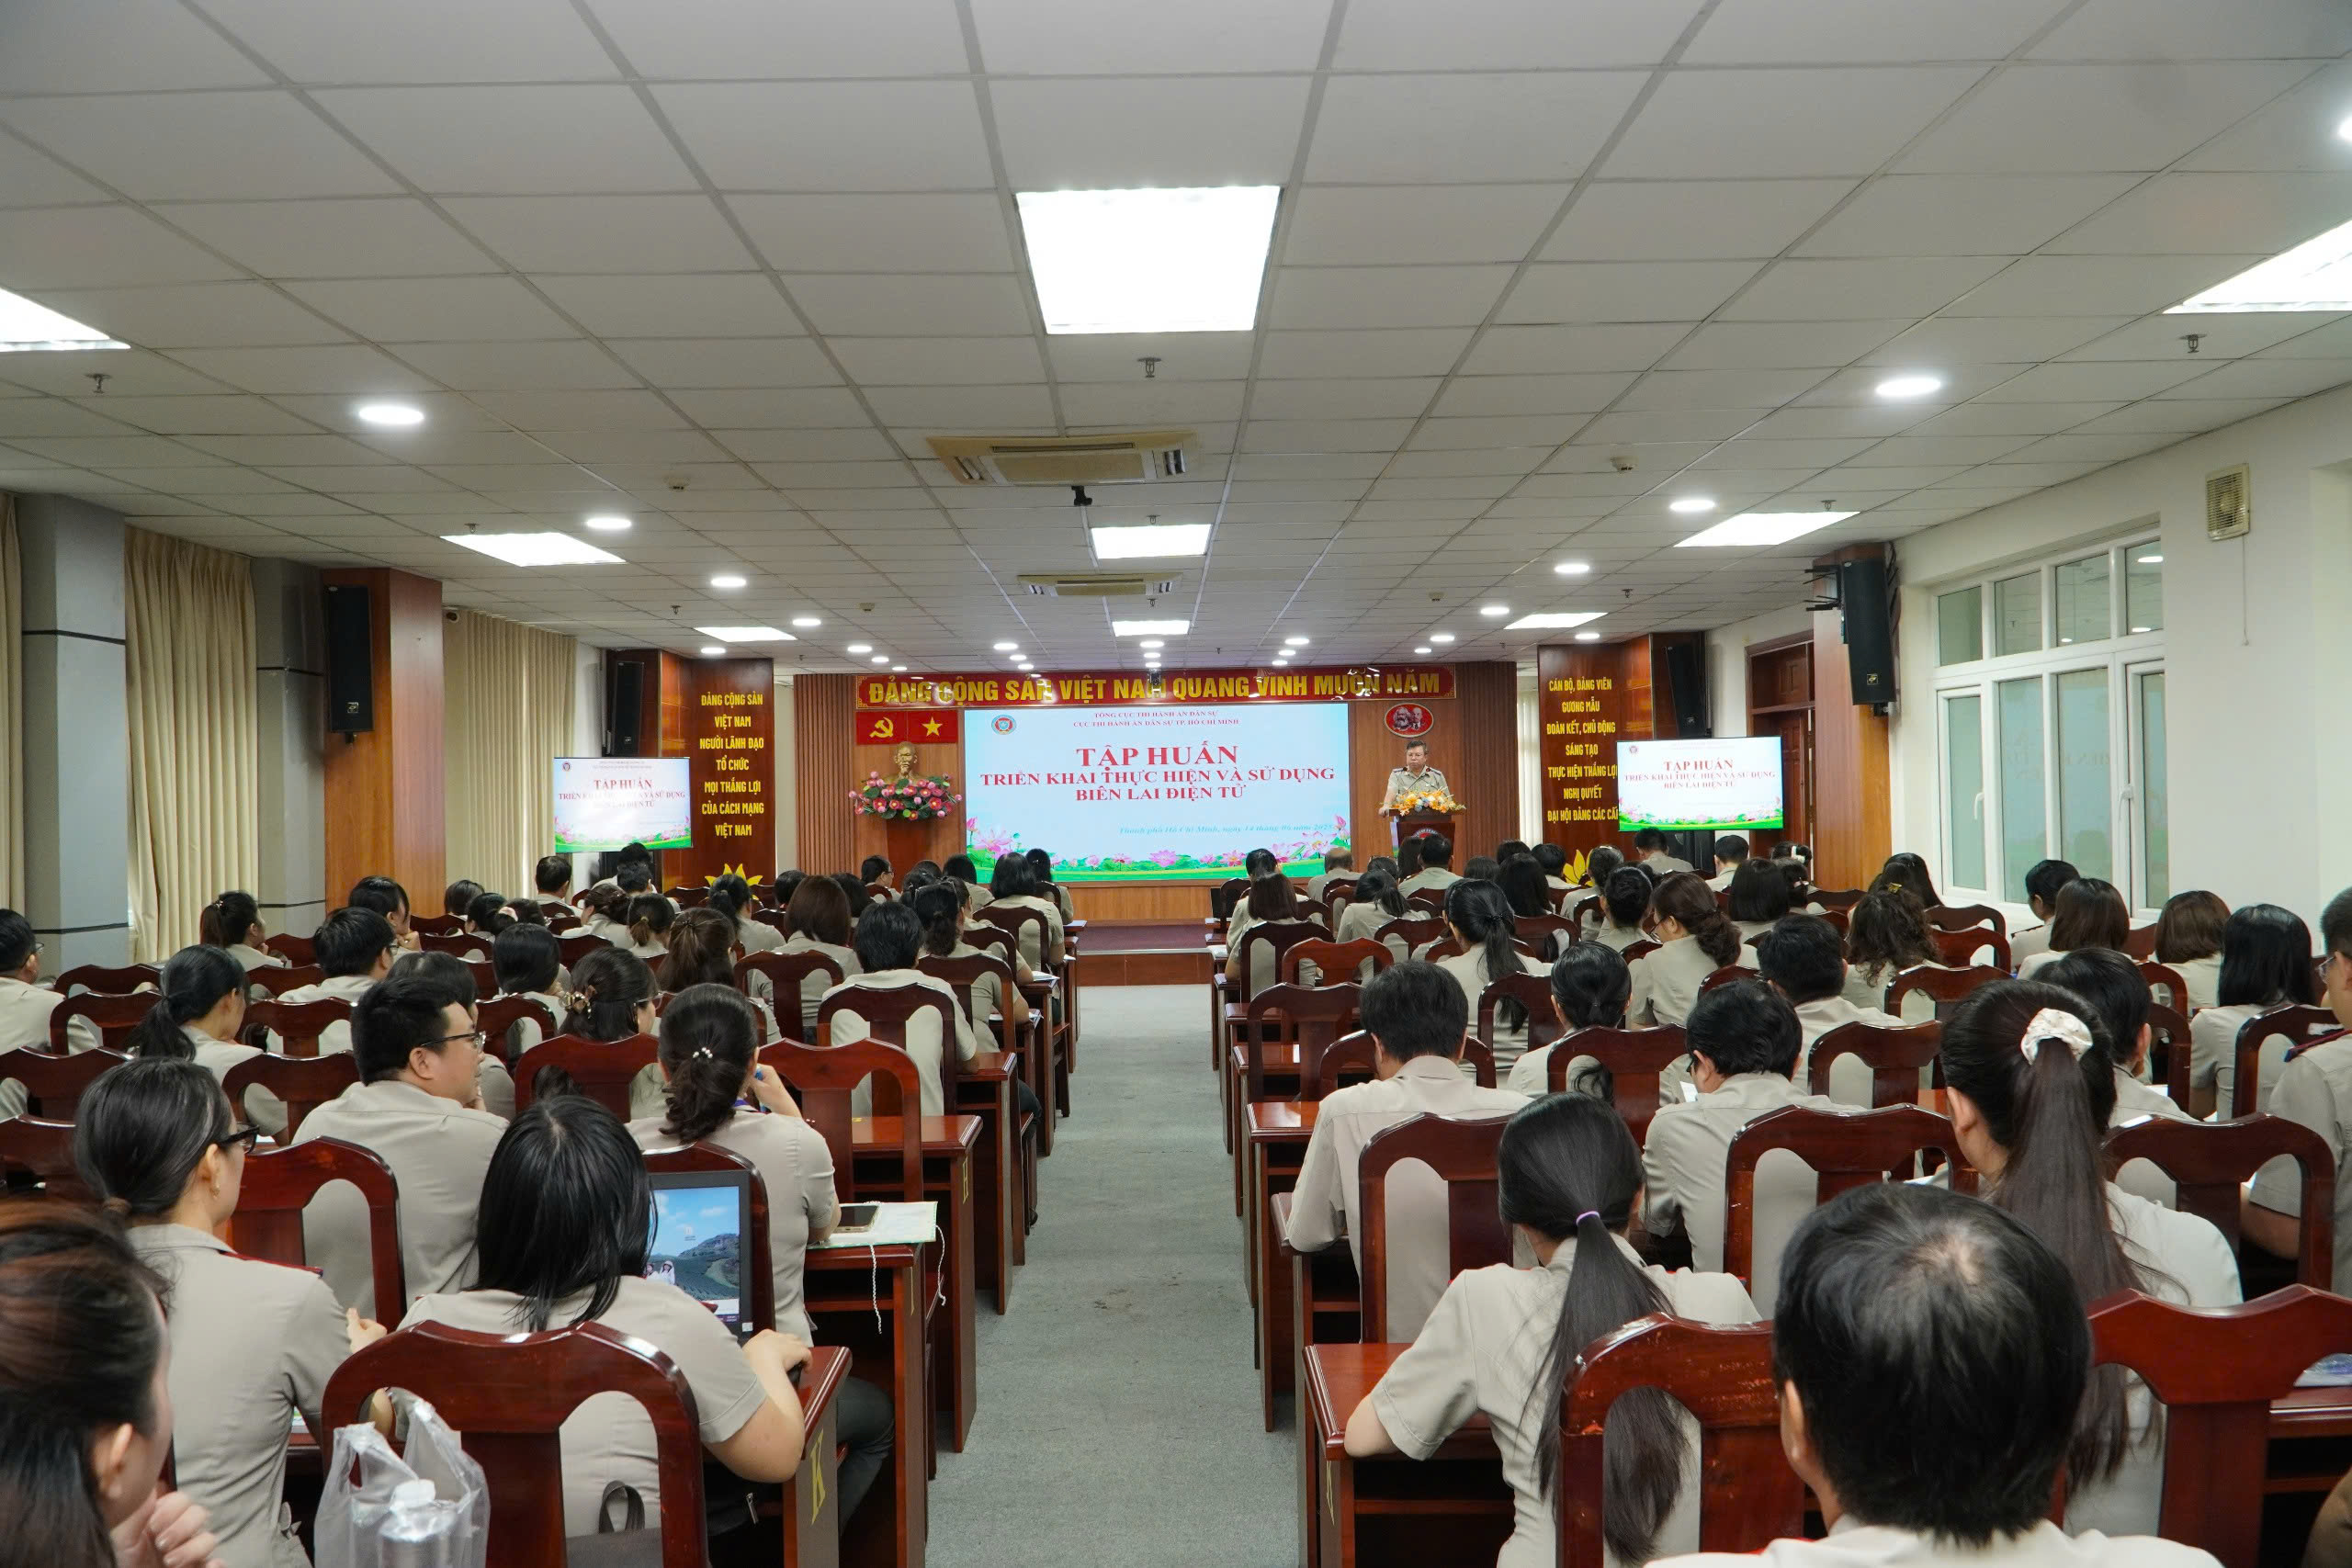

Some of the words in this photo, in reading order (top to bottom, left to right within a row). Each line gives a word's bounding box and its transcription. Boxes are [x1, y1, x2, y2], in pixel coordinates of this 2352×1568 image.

[869, 675, 932, 703] ĐẢNG
[938, 675, 998, 705] CỘNG
[1005, 673, 1053, 700] SẢN
[1059, 674, 1106, 704] VIỆT
[1172, 677, 1250, 700] QUANG
[1255, 675, 1307, 697] VINH
[1549, 678, 1563, 691] CÁN
[1577, 676, 1595, 690] ĐẢNG
[1596, 676, 1611, 690] VIÊN
[701, 691, 723, 705] ĐẢNG
[724, 692, 745, 708] CỘNG
[747, 691, 763, 705] SẢN
[1562, 701, 1585, 713] GƯƠNG
[714, 714, 732, 730] VIỆT
[734, 716, 752, 728] NAM
[1546, 721, 1565, 735] ĐOÀN
[1582, 719, 1597, 733] CHỦ
[1597, 719, 1615, 736] ĐỘNG
[699, 735, 723, 750] NGƯỜI
[725, 736, 746, 750] LÃNH
[748, 738, 764, 751] ĐẠO
[1566, 742, 1583, 756] SÁNG
[1585, 744, 1599, 758] TẠO
[716, 755, 727, 771] TỔ
[729, 757, 750, 771] CHỨC
[1076, 745, 1139, 771] TẬP
[1147, 740, 1238, 765] HUẤN
[980, 769, 1041, 785] TRIỂN
[1046, 772, 1096, 784] KHAI
[1102, 770, 1158, 785] THỰC
[1163, 769, 1211, 784] HIỆN
[1216, 767, 1243, 782] VÀ
[1248, 766, 1275, 781] SỬ
[1279, 768, 1335, 783] DỤNG
[1548, 766, 1566, 781] THỰC
[1566, 764, 1583, 780] HIỆN
[1584, 761, 1606, 777] THẮNG
[1607, 764, 1618, 779] LỢI
[704, 782, 718, 795] MỌI
[720, 777, 746, 793] THẮNG
[748, 780, 761, 795] LỢI
[1076, 786, 1121, 801] BIÊN
[1128, 786, 1160, 799] LAI
[1166, 786, 1213, 802] ĐIỆN
[1217, 783, 1247, 798] TỬ
[1563, 788, 1579, 801] NGHỊ
[1580, 784, 1602, 800] QUYẾT
[702, 800, 718, 815] CỦA
[719, 801, 741, 815] CÁCH
[741, 803, 764, 817] MẠNG
[1547, 810, 1559, 824] ĐẠI
[1560, 807, 1571, 824] HỘI
[1573, 807, 1591, 821] ĐẢNG
[1592, 807, 1606, 821] CÁC
[715, 822, 733, 839] VIỆT
[735, 825, 752, 837] NAM
[810, 1428, 826, 1525] K
